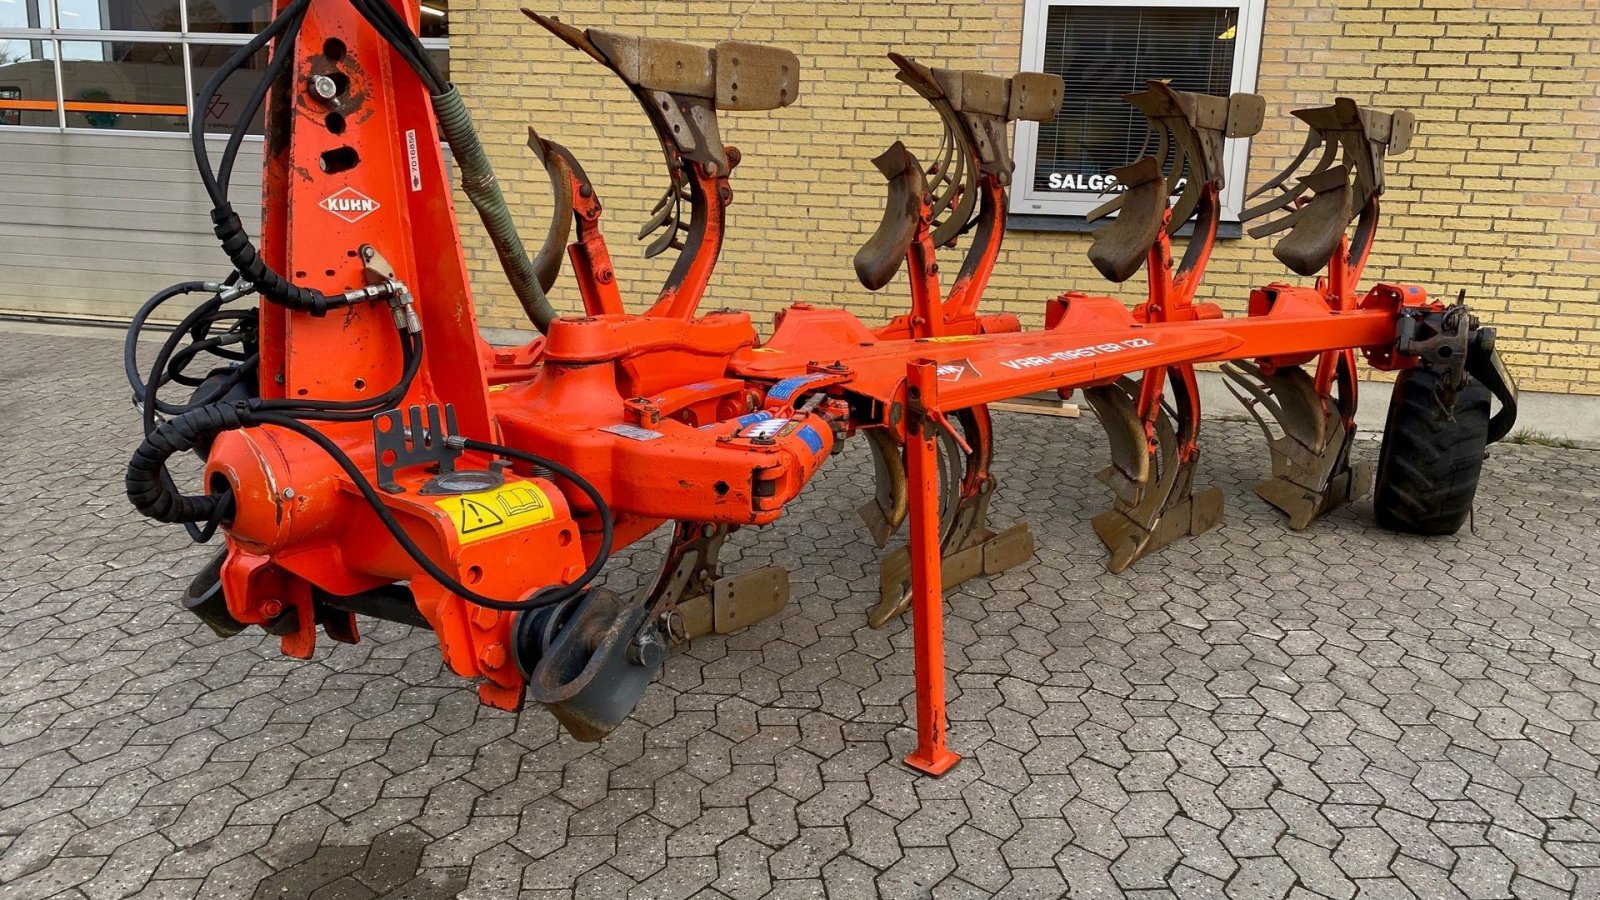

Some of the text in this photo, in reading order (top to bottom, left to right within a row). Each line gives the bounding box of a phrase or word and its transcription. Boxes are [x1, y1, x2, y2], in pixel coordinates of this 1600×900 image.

[407, 131, 418, 173] 7016856
[327, 198, 373, 212] KUHN
[1000, 338, 1154, 370] VARI-MASTER 122
